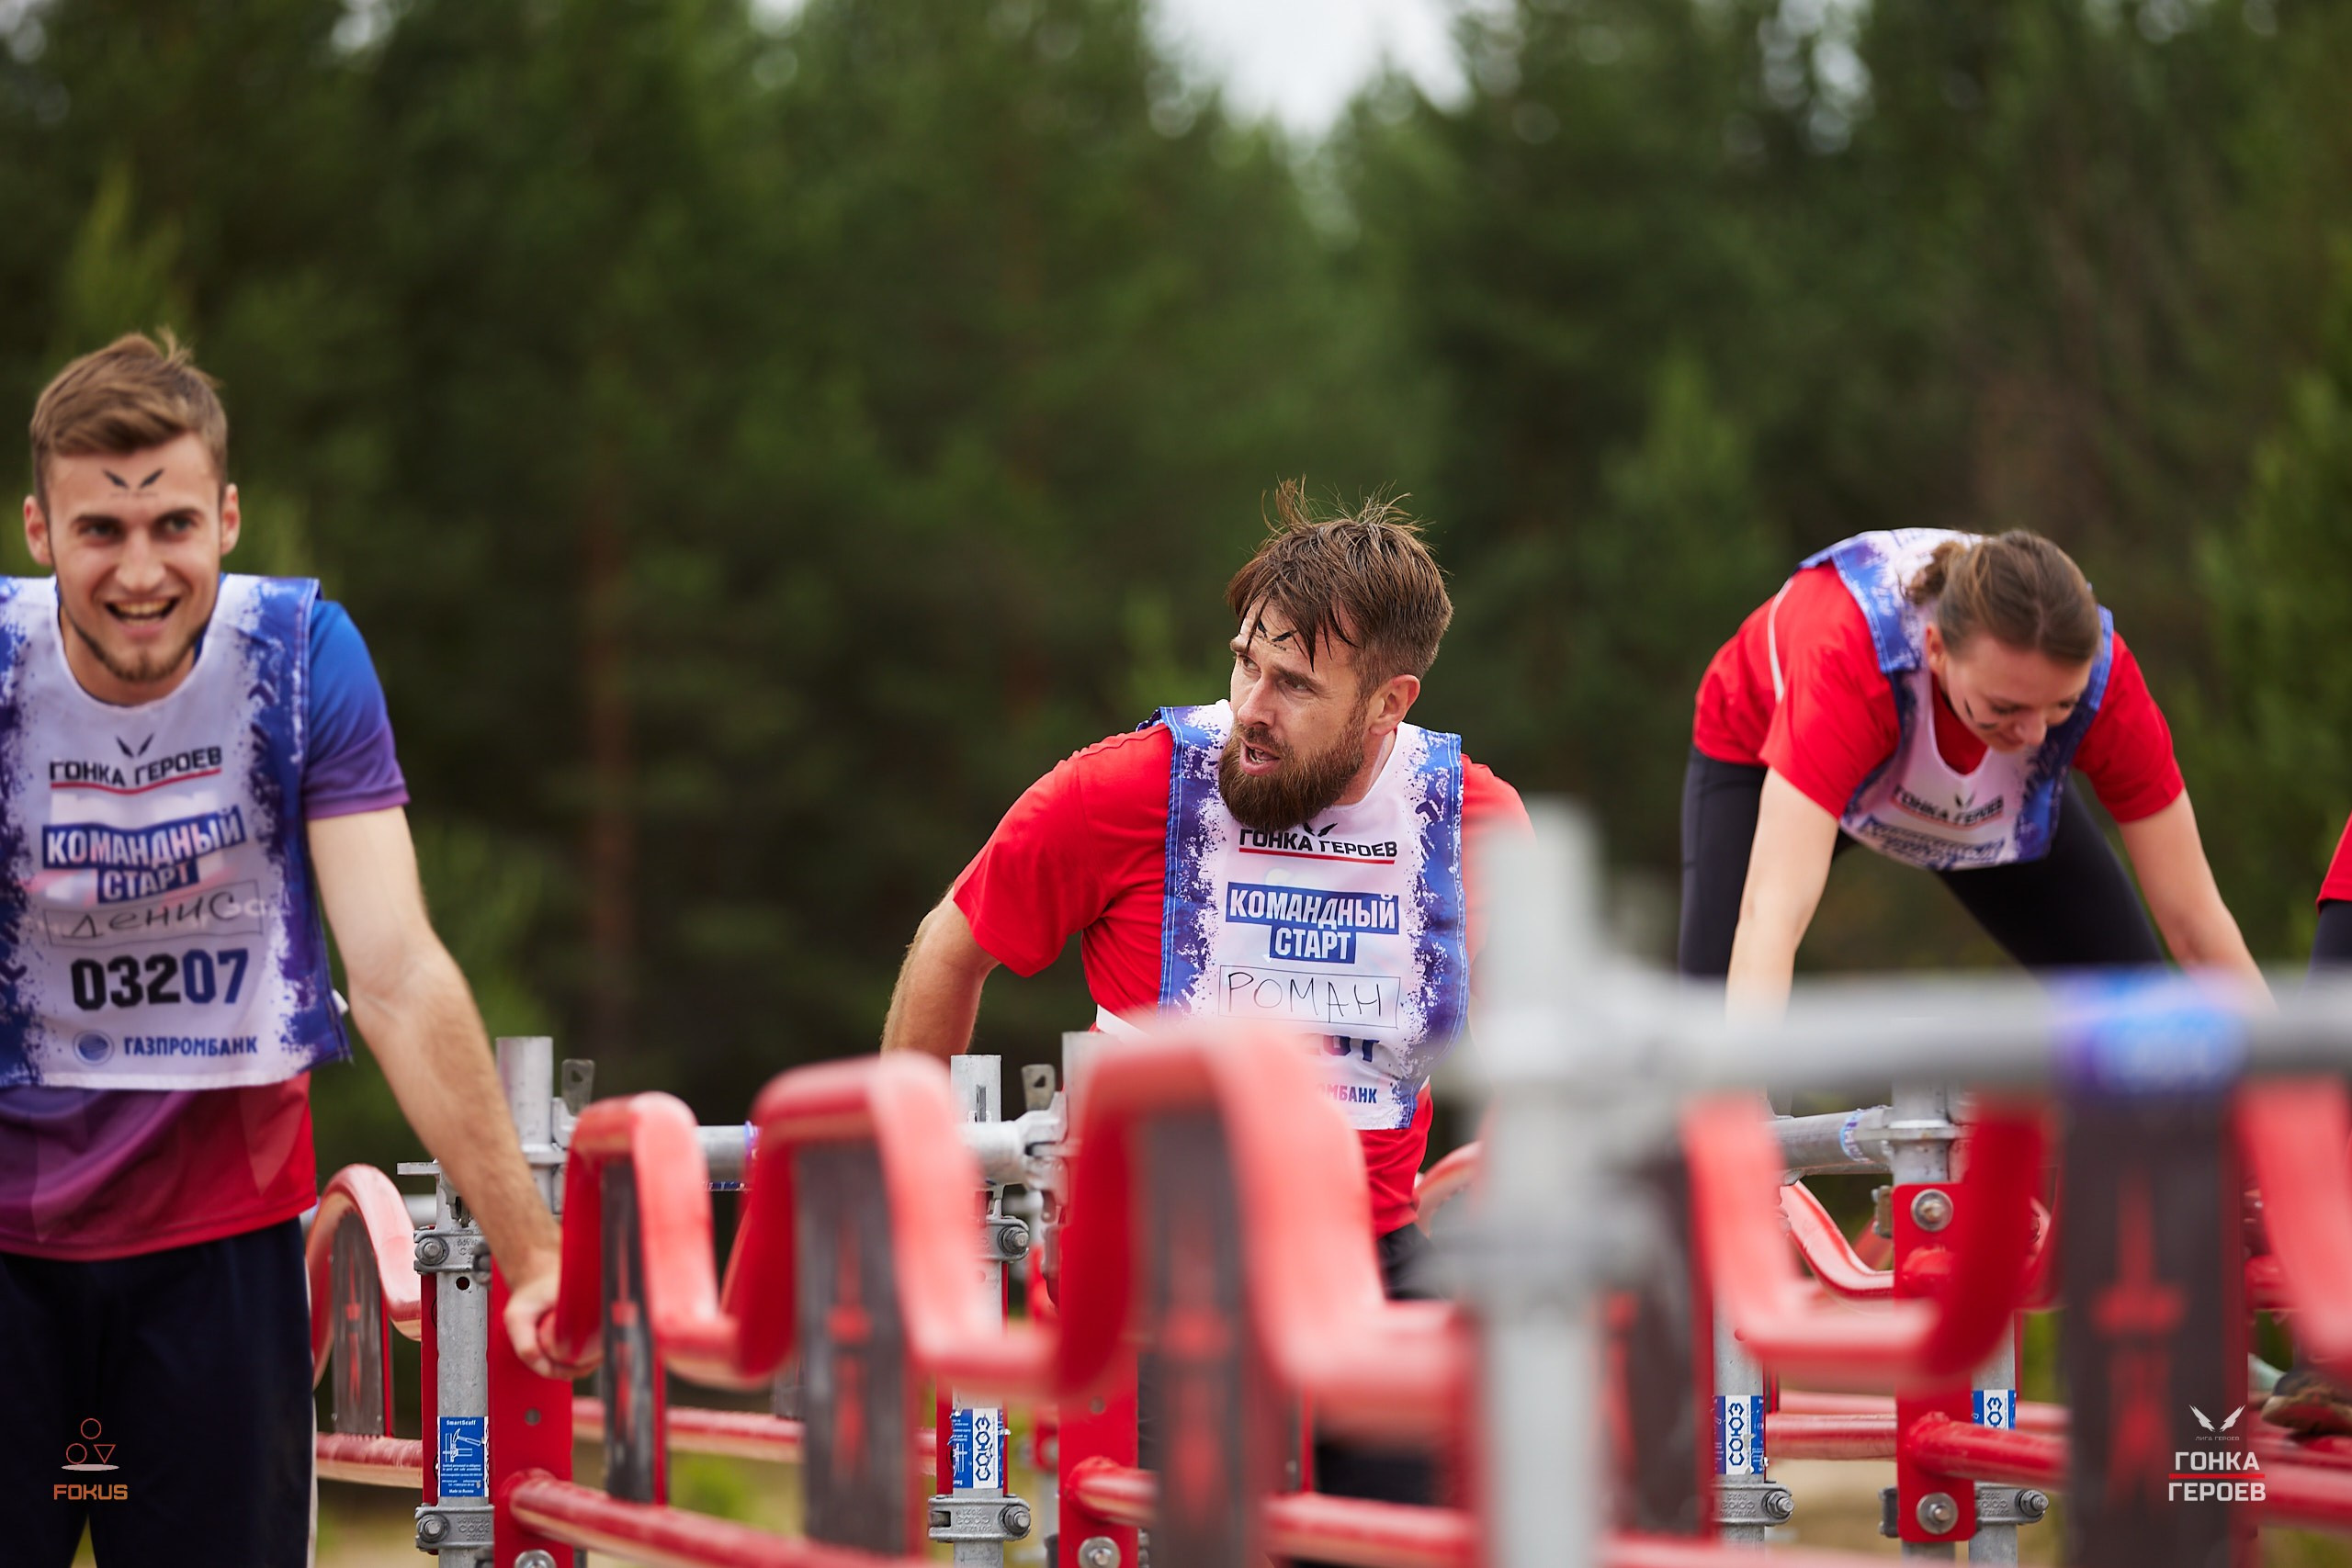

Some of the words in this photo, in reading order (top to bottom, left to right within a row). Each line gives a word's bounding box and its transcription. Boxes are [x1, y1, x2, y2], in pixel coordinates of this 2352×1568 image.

[50, 761, 126, 787] ГОНКА
[134, 746, 222, 785] ГЕРОЕВ
[47, 806, 243, 869] КОМАНДНЫЙ
[1238, 829, 1315, 852] ГОНКА
[1318, 840, 1398, 858] ГЕРОЕВ
[102, 862, 192, 901] СТАРТ
[1229, 888, 1396, 931] КОМАНДНЫЙ
[1273, 927, 1351, 960] СТАРТ
[70, 948, 250, 1011] 03207
[1227, 971, 1383, 1023] РОМАН
[124, 1034, 258, 1057] ГАЗПРОМБАНК
